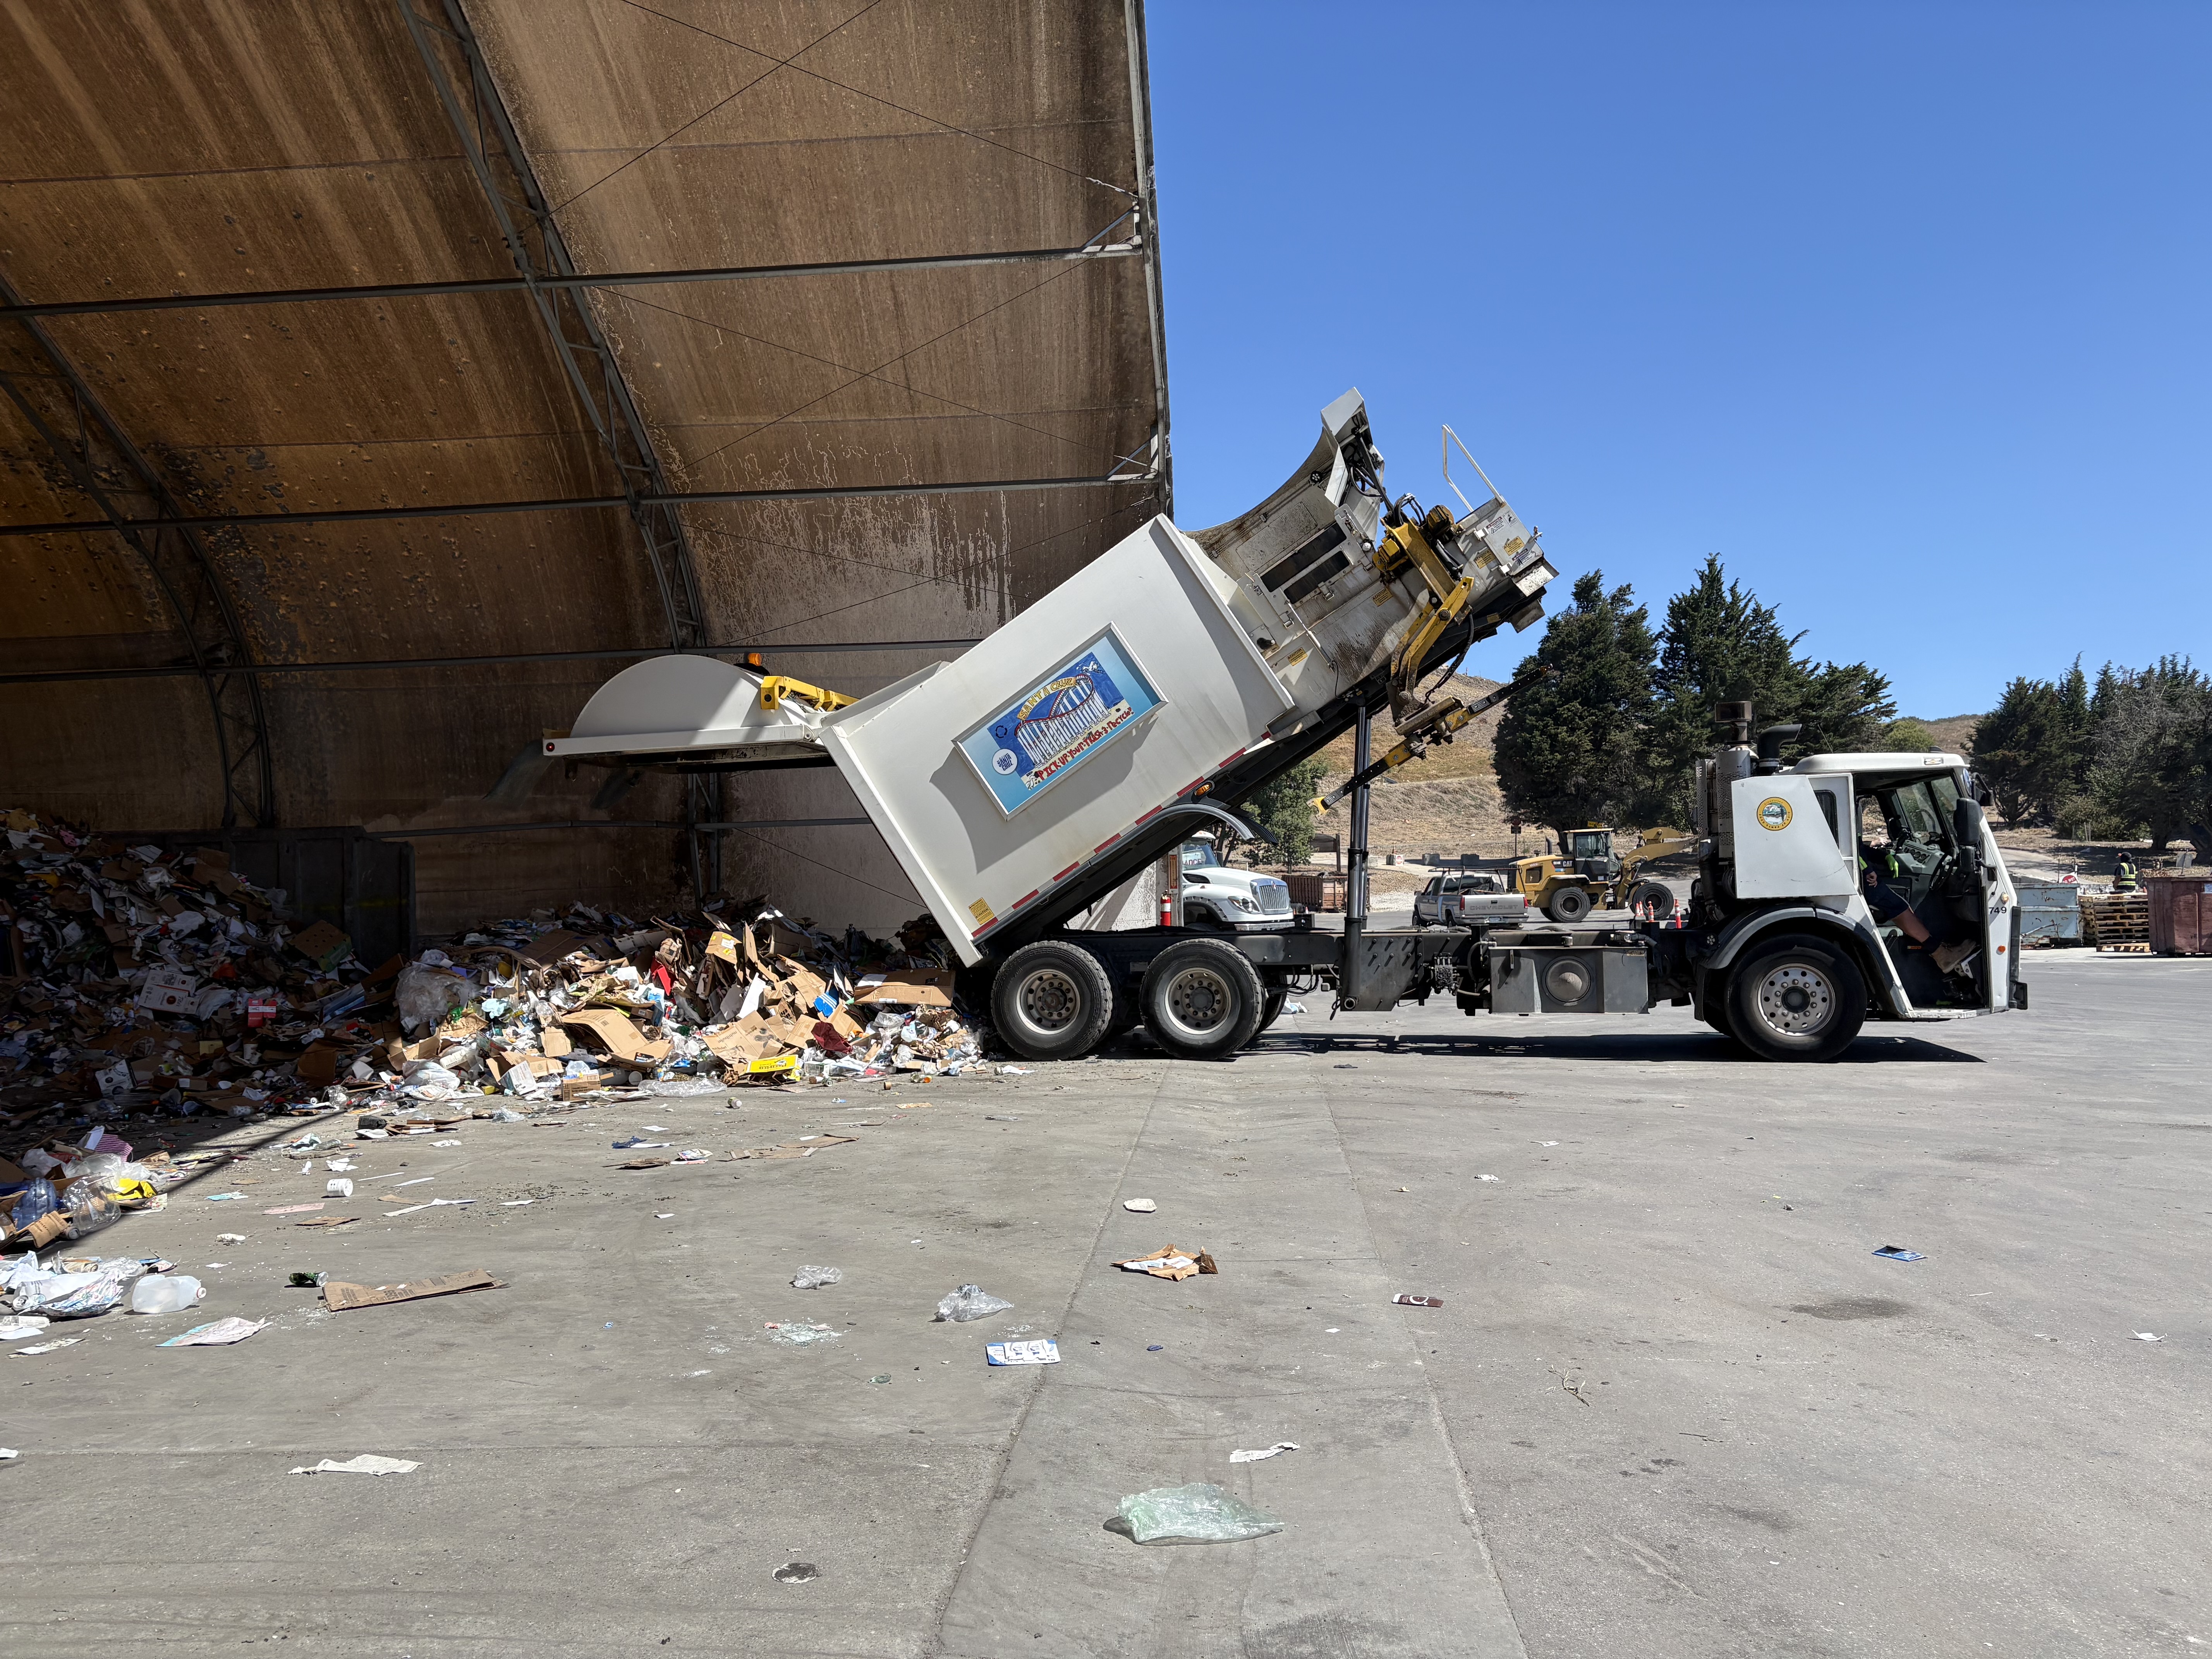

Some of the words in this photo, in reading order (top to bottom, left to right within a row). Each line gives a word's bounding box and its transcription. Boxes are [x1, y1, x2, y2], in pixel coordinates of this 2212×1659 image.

[1019, 687, 1050, 719] SANTA
[1051, 678, 1073, 691] CRUZ
[997, 753, 1012, 767] SANTA
[1001, 760, 1013, 771] CRUZ
[1037, 760, 1061, 781] PICK
[1058, 753, 1068, 765] UP
[717, 1030, 737, 1044] nutribullet
